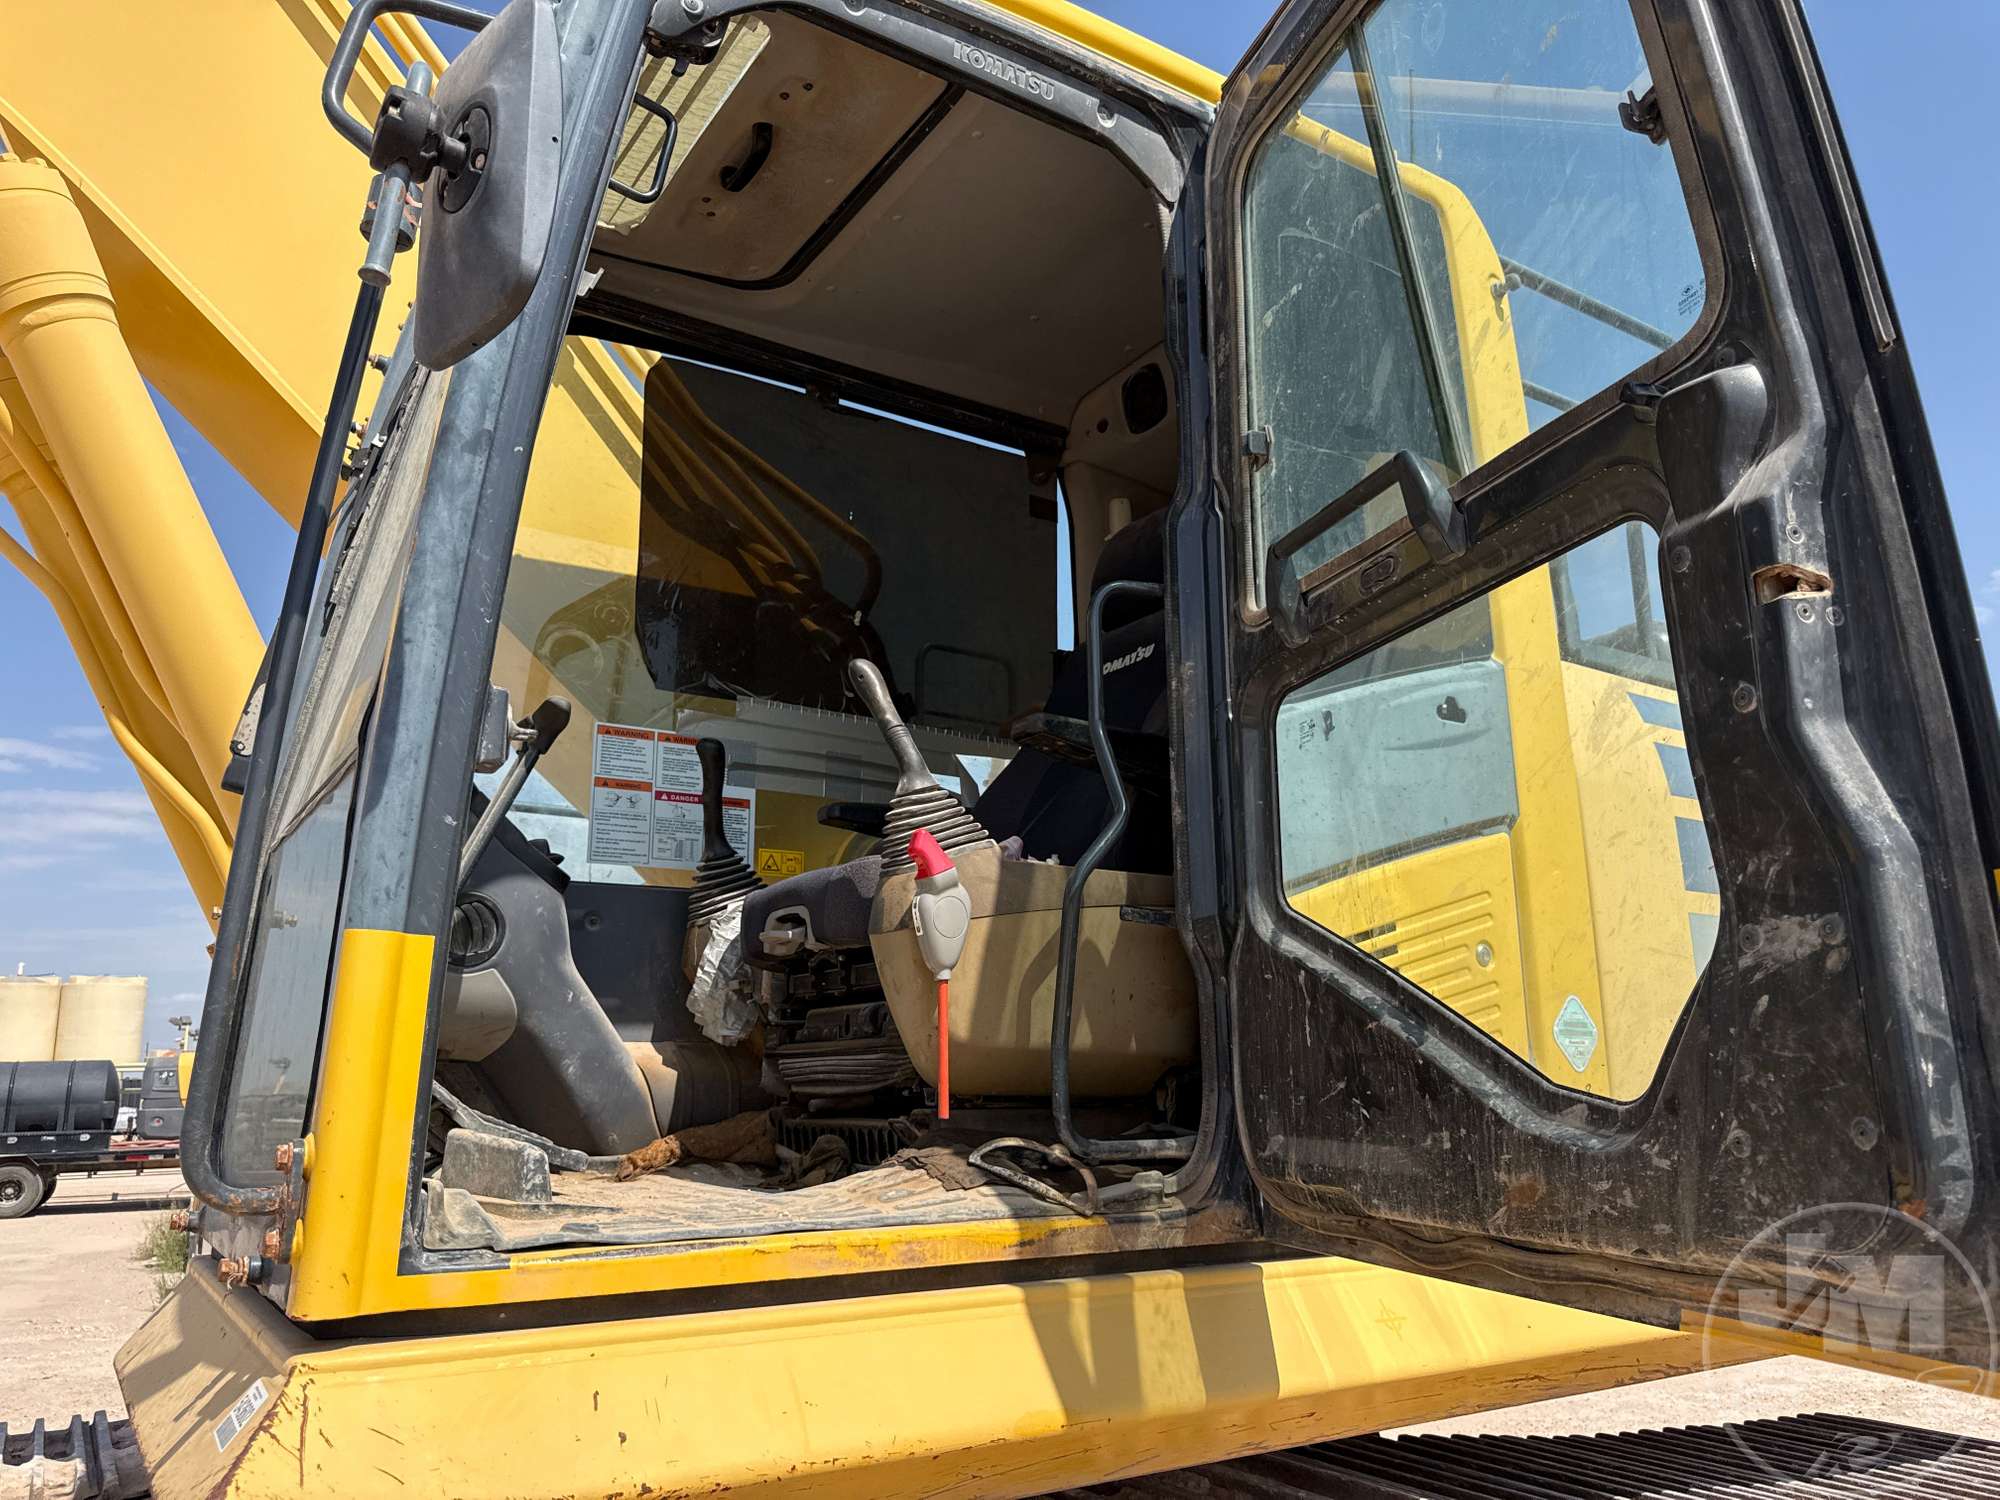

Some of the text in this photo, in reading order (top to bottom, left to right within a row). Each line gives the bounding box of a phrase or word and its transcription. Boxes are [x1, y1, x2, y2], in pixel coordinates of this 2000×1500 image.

[953, 40, 1055, 100] KOMATSU
[1102, 643, 1155, 675] OMATSU
[614, 728, 649, 739] WARNING
[670, 794, 699, 802] DANGER
